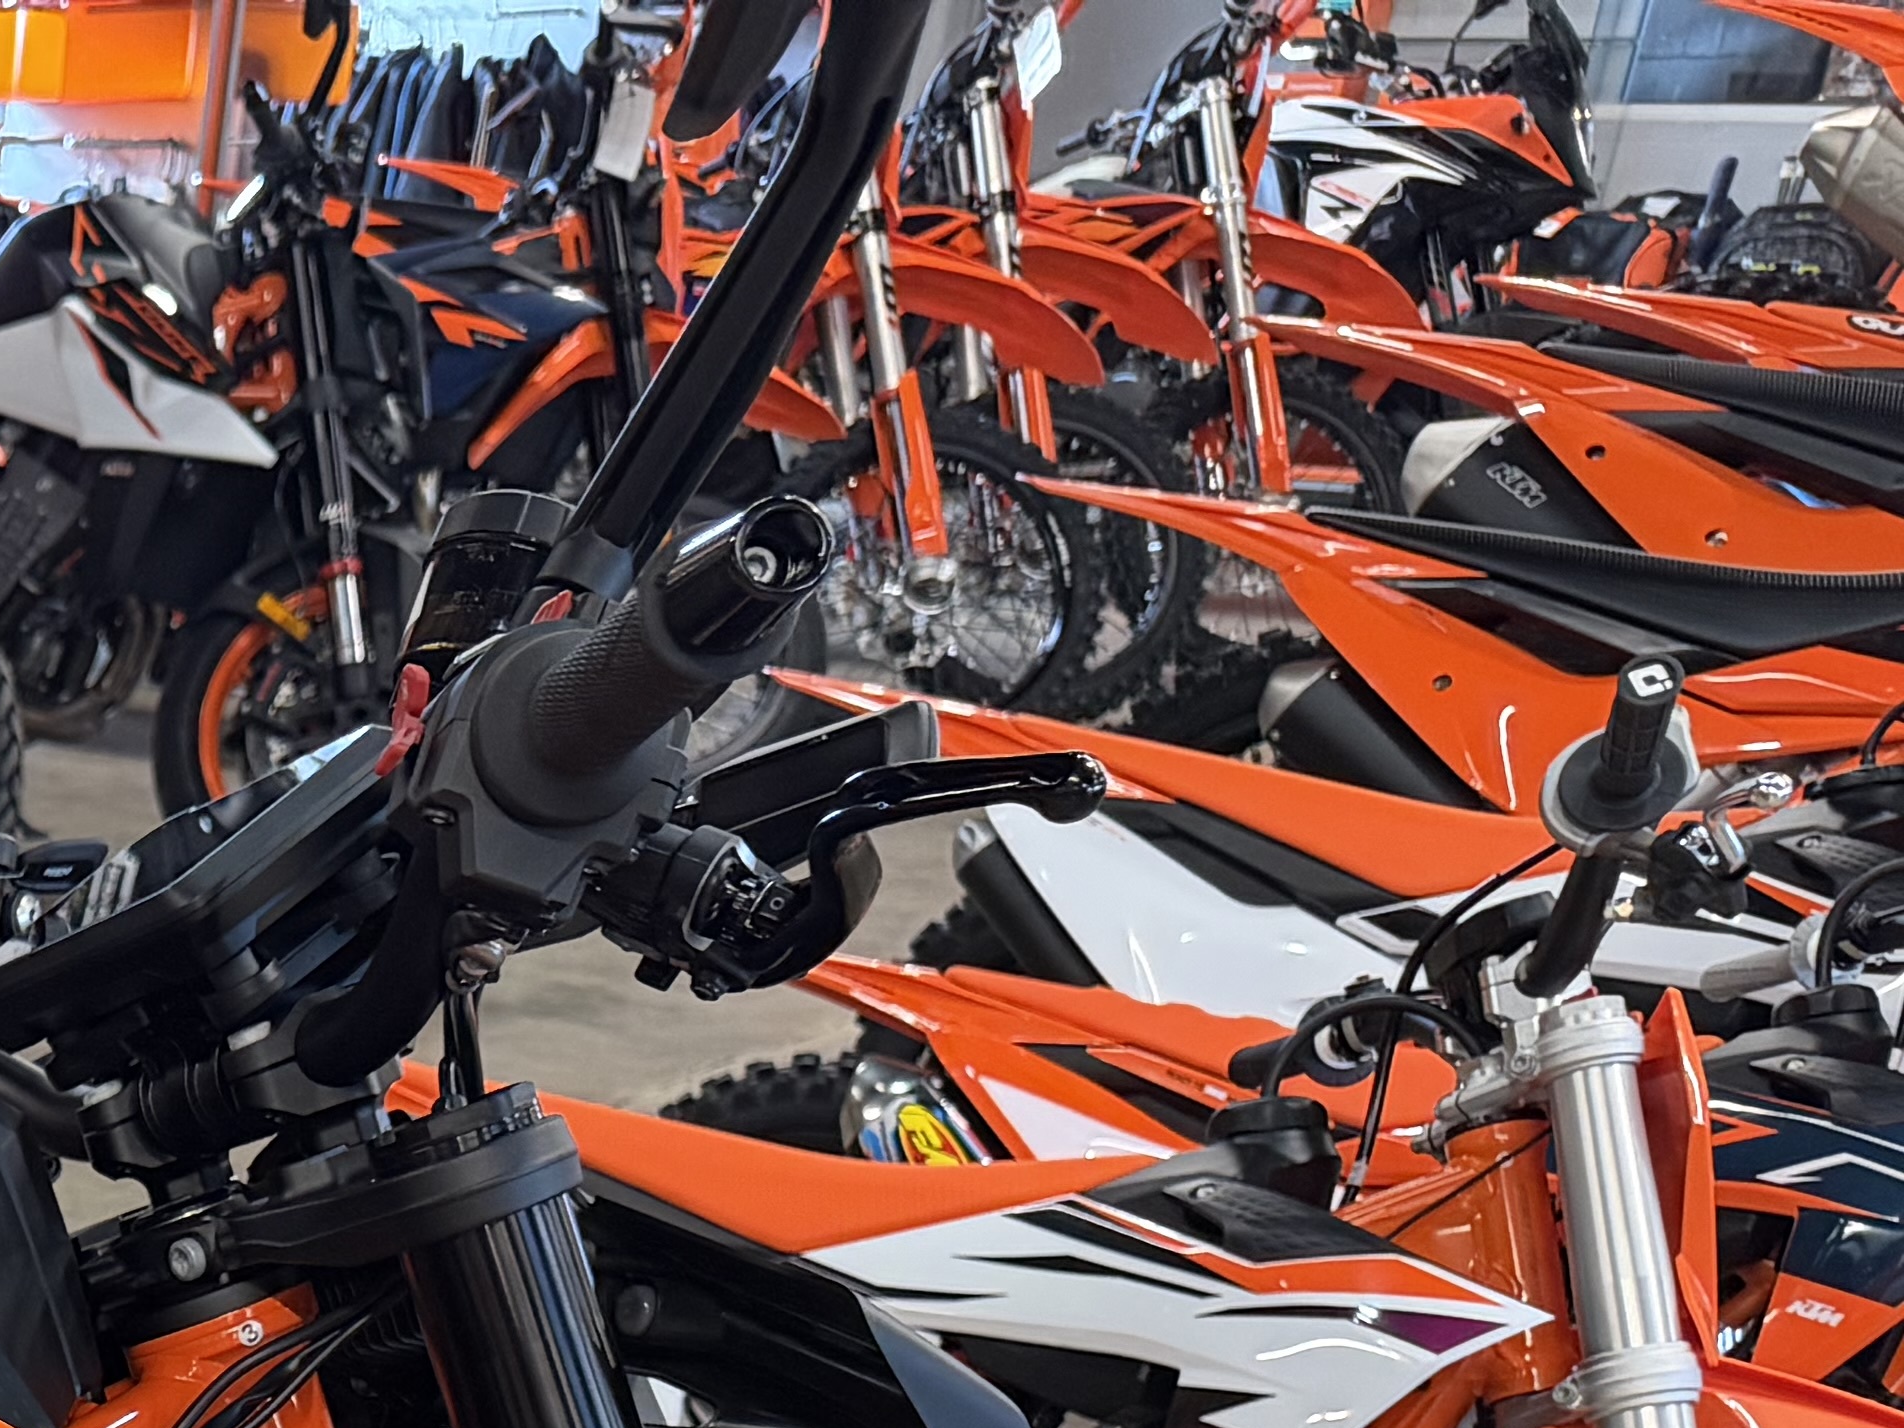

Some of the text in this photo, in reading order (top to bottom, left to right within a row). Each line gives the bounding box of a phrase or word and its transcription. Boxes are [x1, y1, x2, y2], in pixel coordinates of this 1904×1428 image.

[1485, 461, 1548, 509] KTM
[1785, 1299, 1846, 1328] KTM
[241, 1322, 261, 1344] 3
